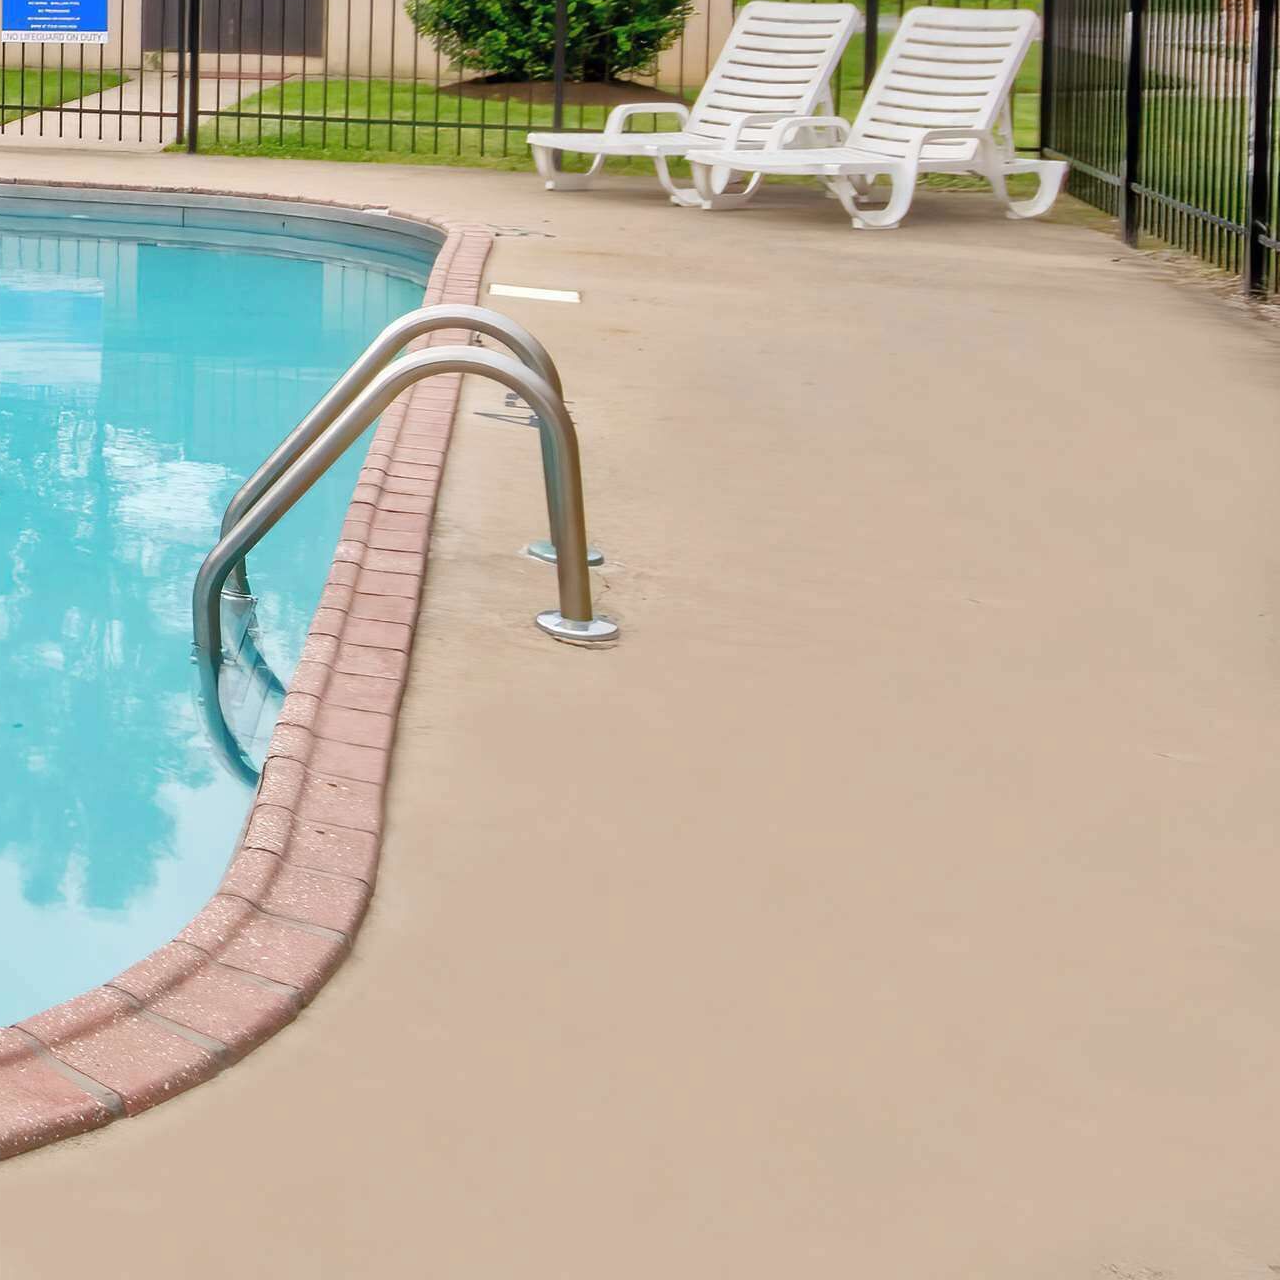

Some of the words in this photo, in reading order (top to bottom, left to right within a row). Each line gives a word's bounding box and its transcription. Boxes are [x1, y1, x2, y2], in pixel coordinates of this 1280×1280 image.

[6, 33, 19, 41] NO
[20, 33, 65, 41] LIFEGUARD
[66, 33, 79, 41] ON
[80, 33, 102, 41] DUTY
